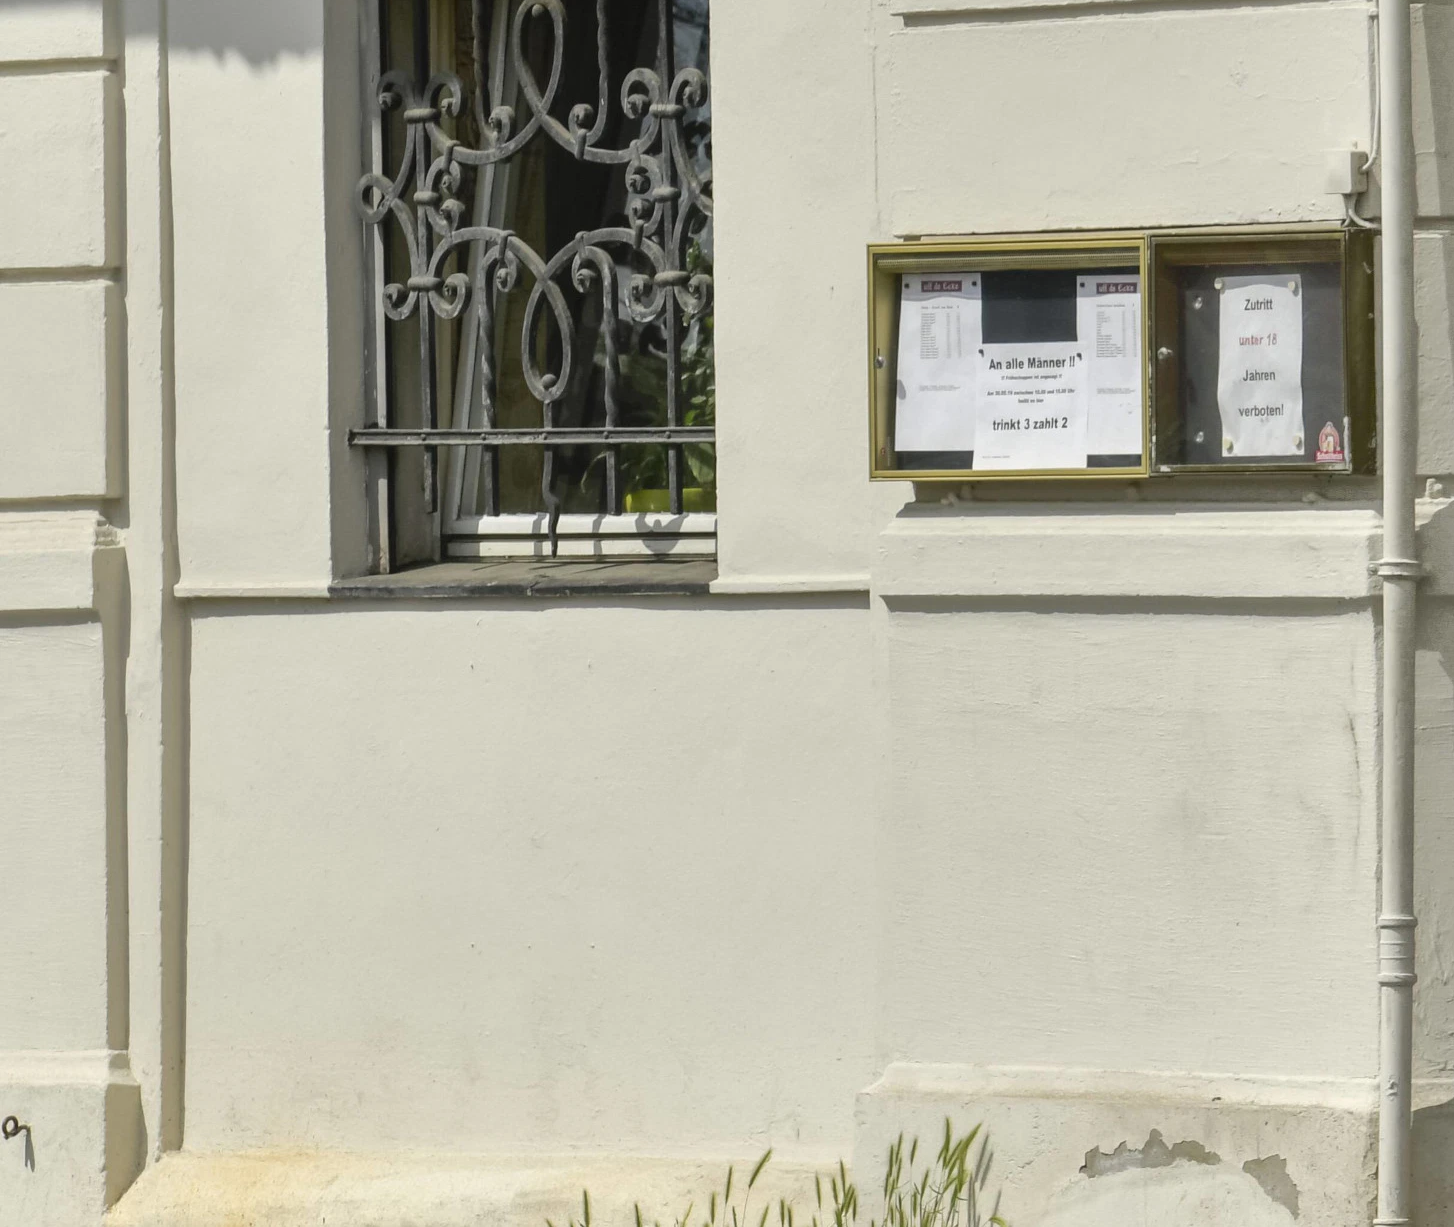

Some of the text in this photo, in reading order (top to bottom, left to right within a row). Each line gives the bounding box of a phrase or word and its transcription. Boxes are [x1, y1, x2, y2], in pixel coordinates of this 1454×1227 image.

[1244, 299, 1273, 311] Zutritt
[1239, 333, 1278, 346] unter 18
[989, 358, 1002, 370] An
[1005, 358, 1024, 369] alle
[1027, 357, 1066, 369] Männer
[1242, 370, 1276, 382] Jahren
[1238, 404, 1284, 417] verboten!
[993, 417, 1068, 431] trinkt 3 zahlt 2
